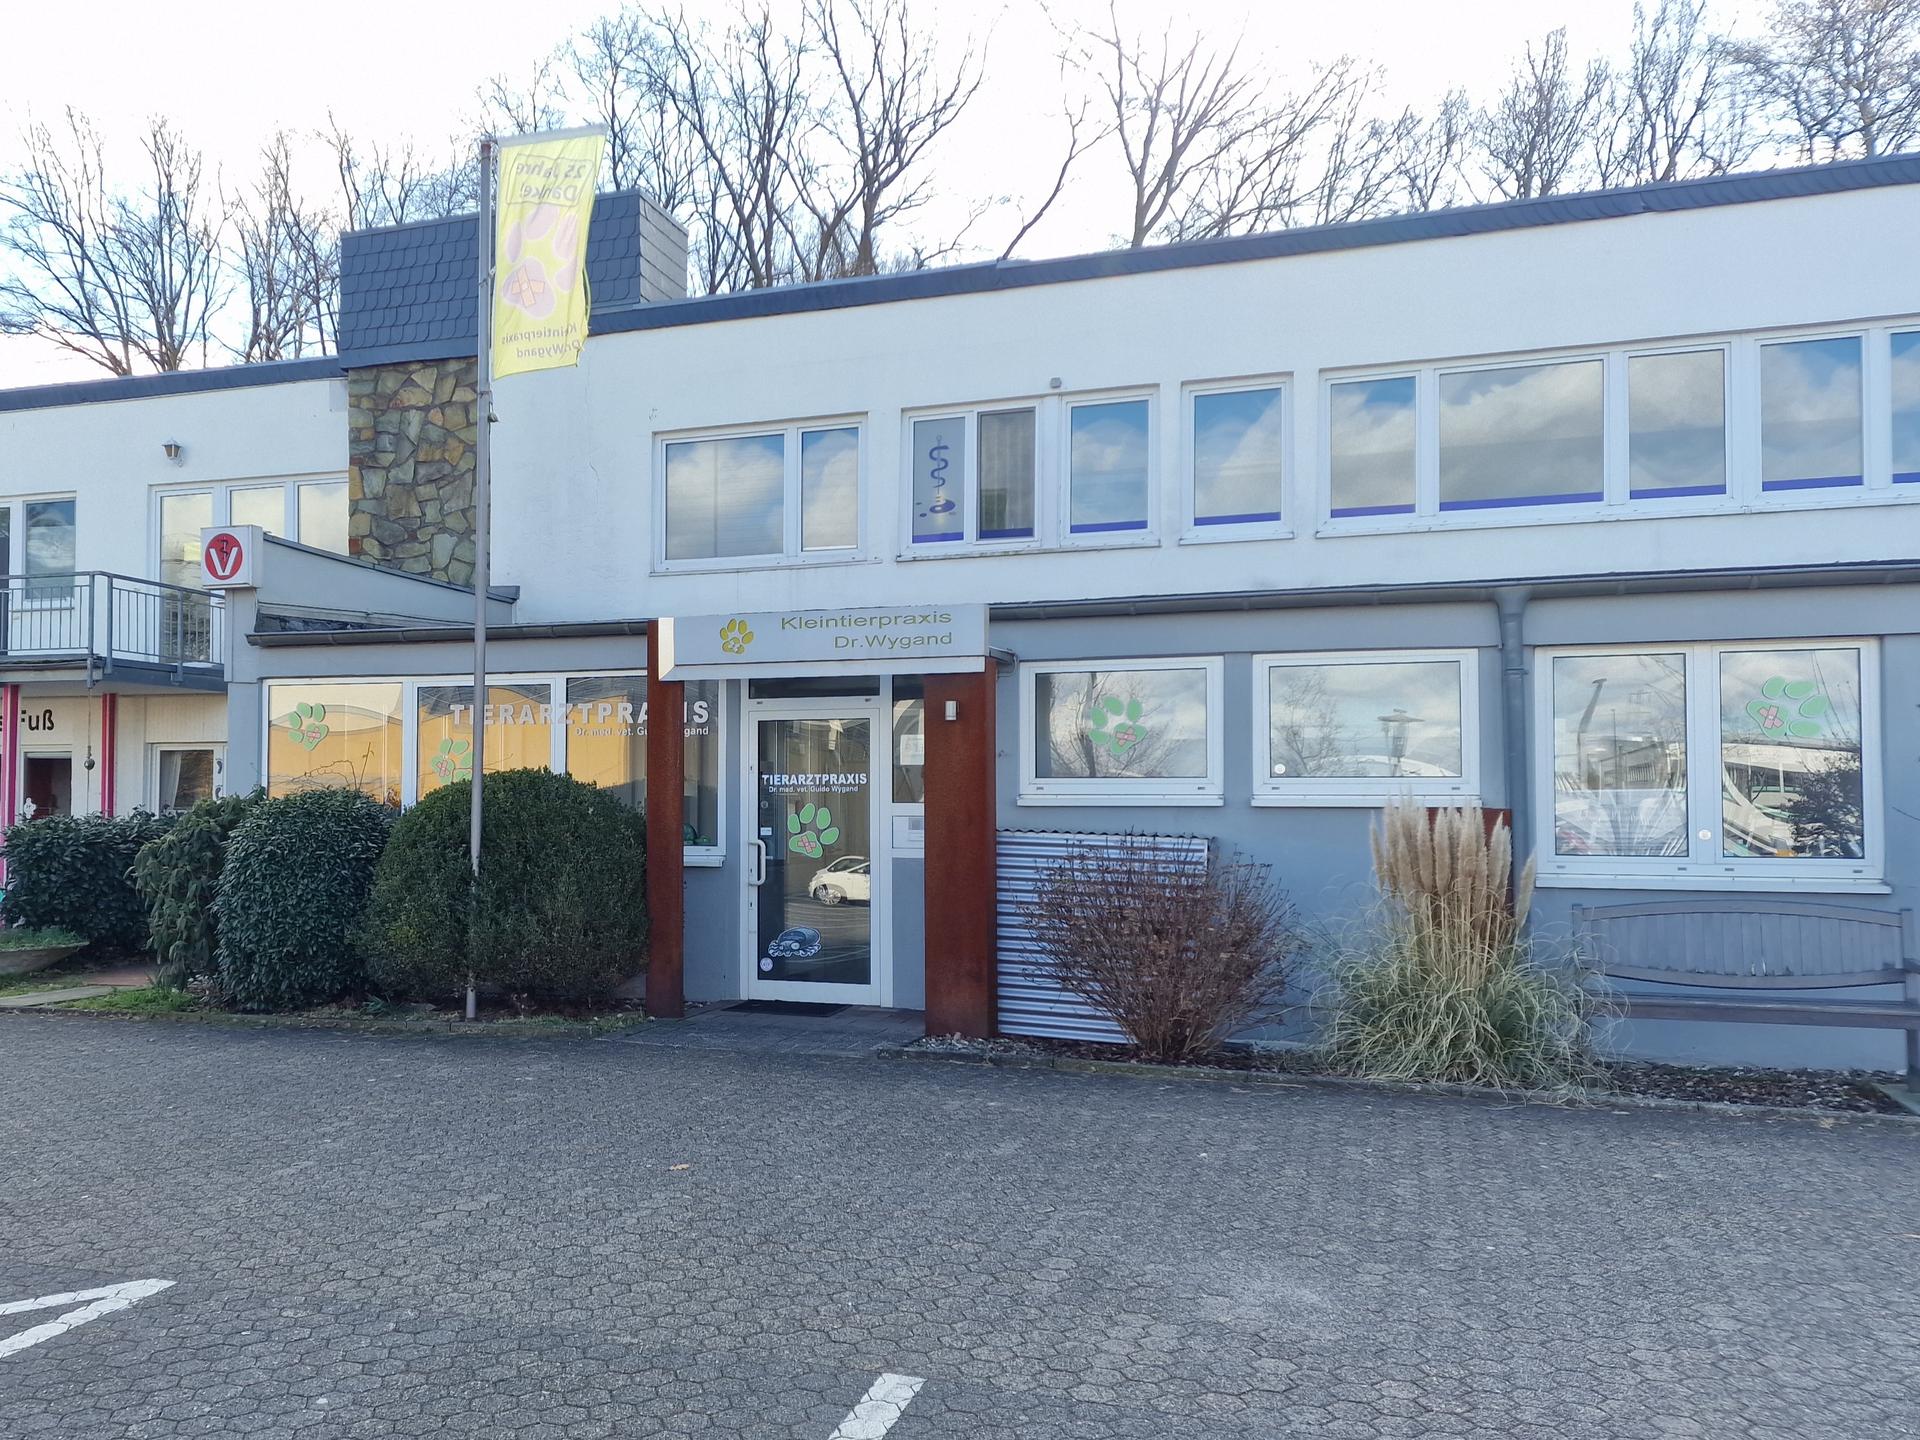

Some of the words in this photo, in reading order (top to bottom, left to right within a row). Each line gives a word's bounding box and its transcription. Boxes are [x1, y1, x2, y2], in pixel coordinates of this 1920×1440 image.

[781, 611, 952, 630] Kleintierpraxis
[834, 632, 952, 649] Dr.Wygand
[449, 700, 709, 725] TIERARZTPRAIS
[762, 773, 867, 785] TIERARZTPRAXIS
[810, 785, 830, 793] Guido
[831, 785, 859, 793] Wygand
